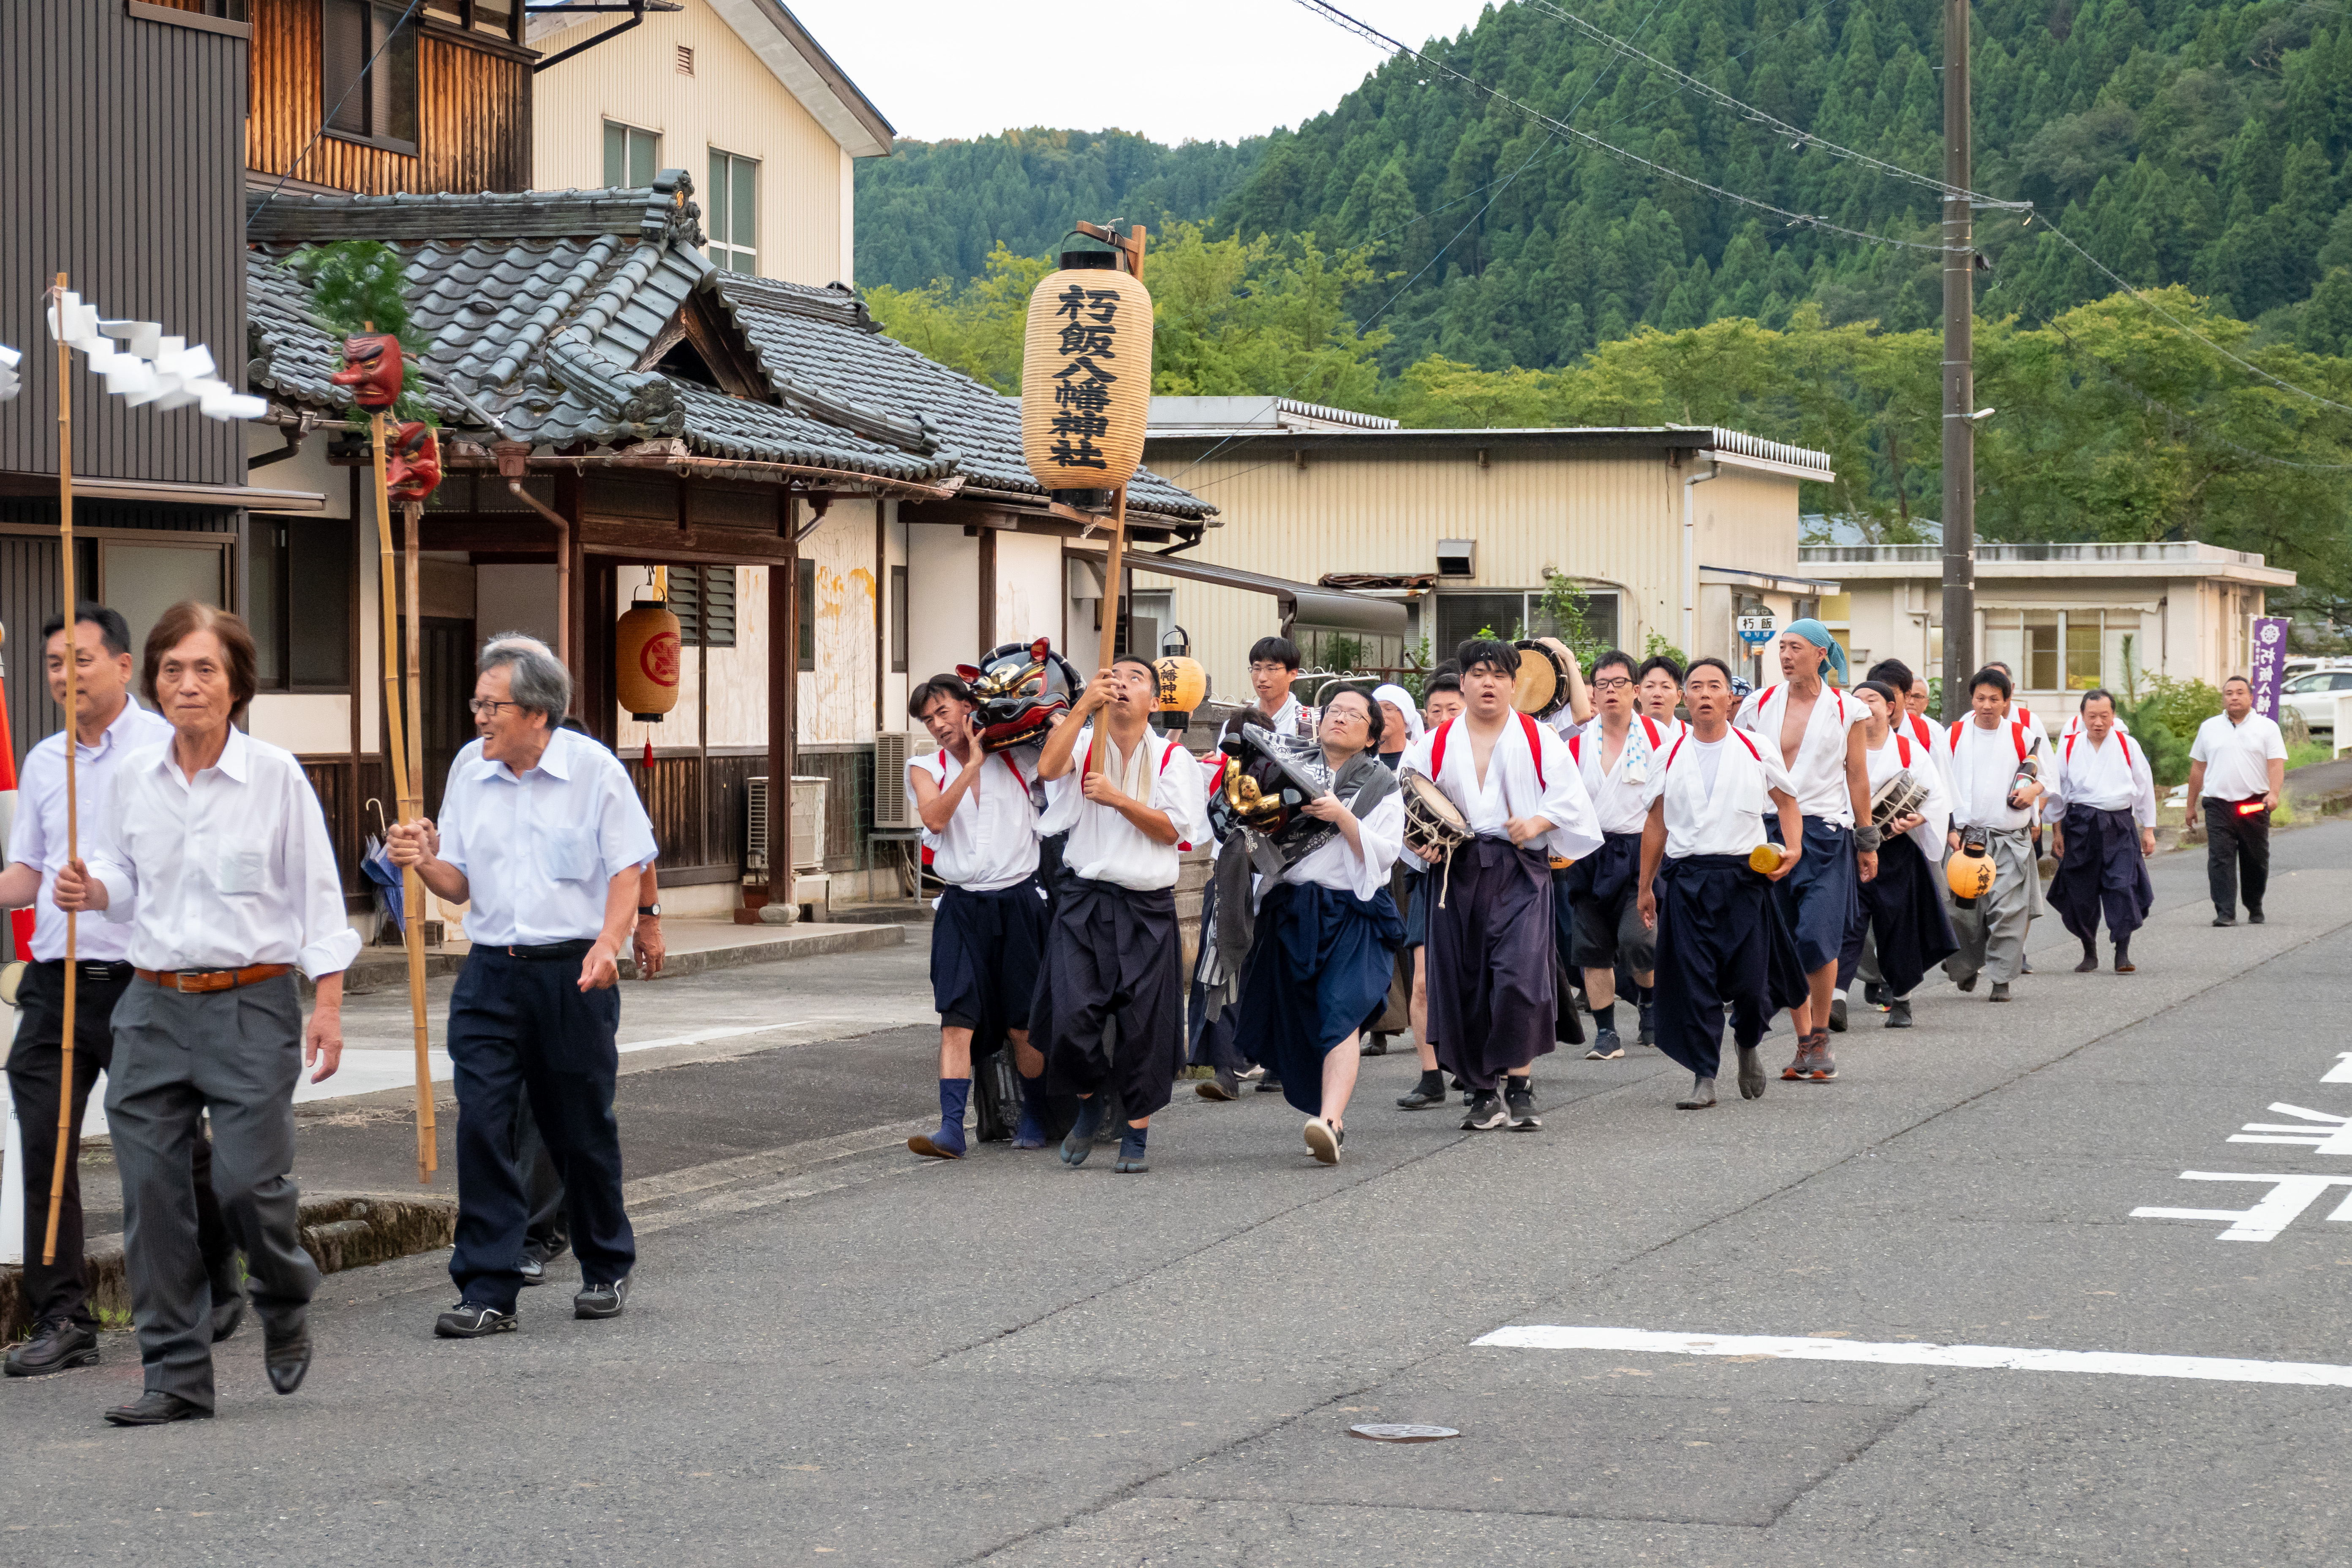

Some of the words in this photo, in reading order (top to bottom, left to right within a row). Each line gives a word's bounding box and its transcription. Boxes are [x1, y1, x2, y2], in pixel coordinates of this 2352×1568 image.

[1047, 284, 1121, 470] 朽飯八幡神社
[1743, 618, 1772, 629] 朽飯
[1159, 659, 1179, 704] 八幡神社
